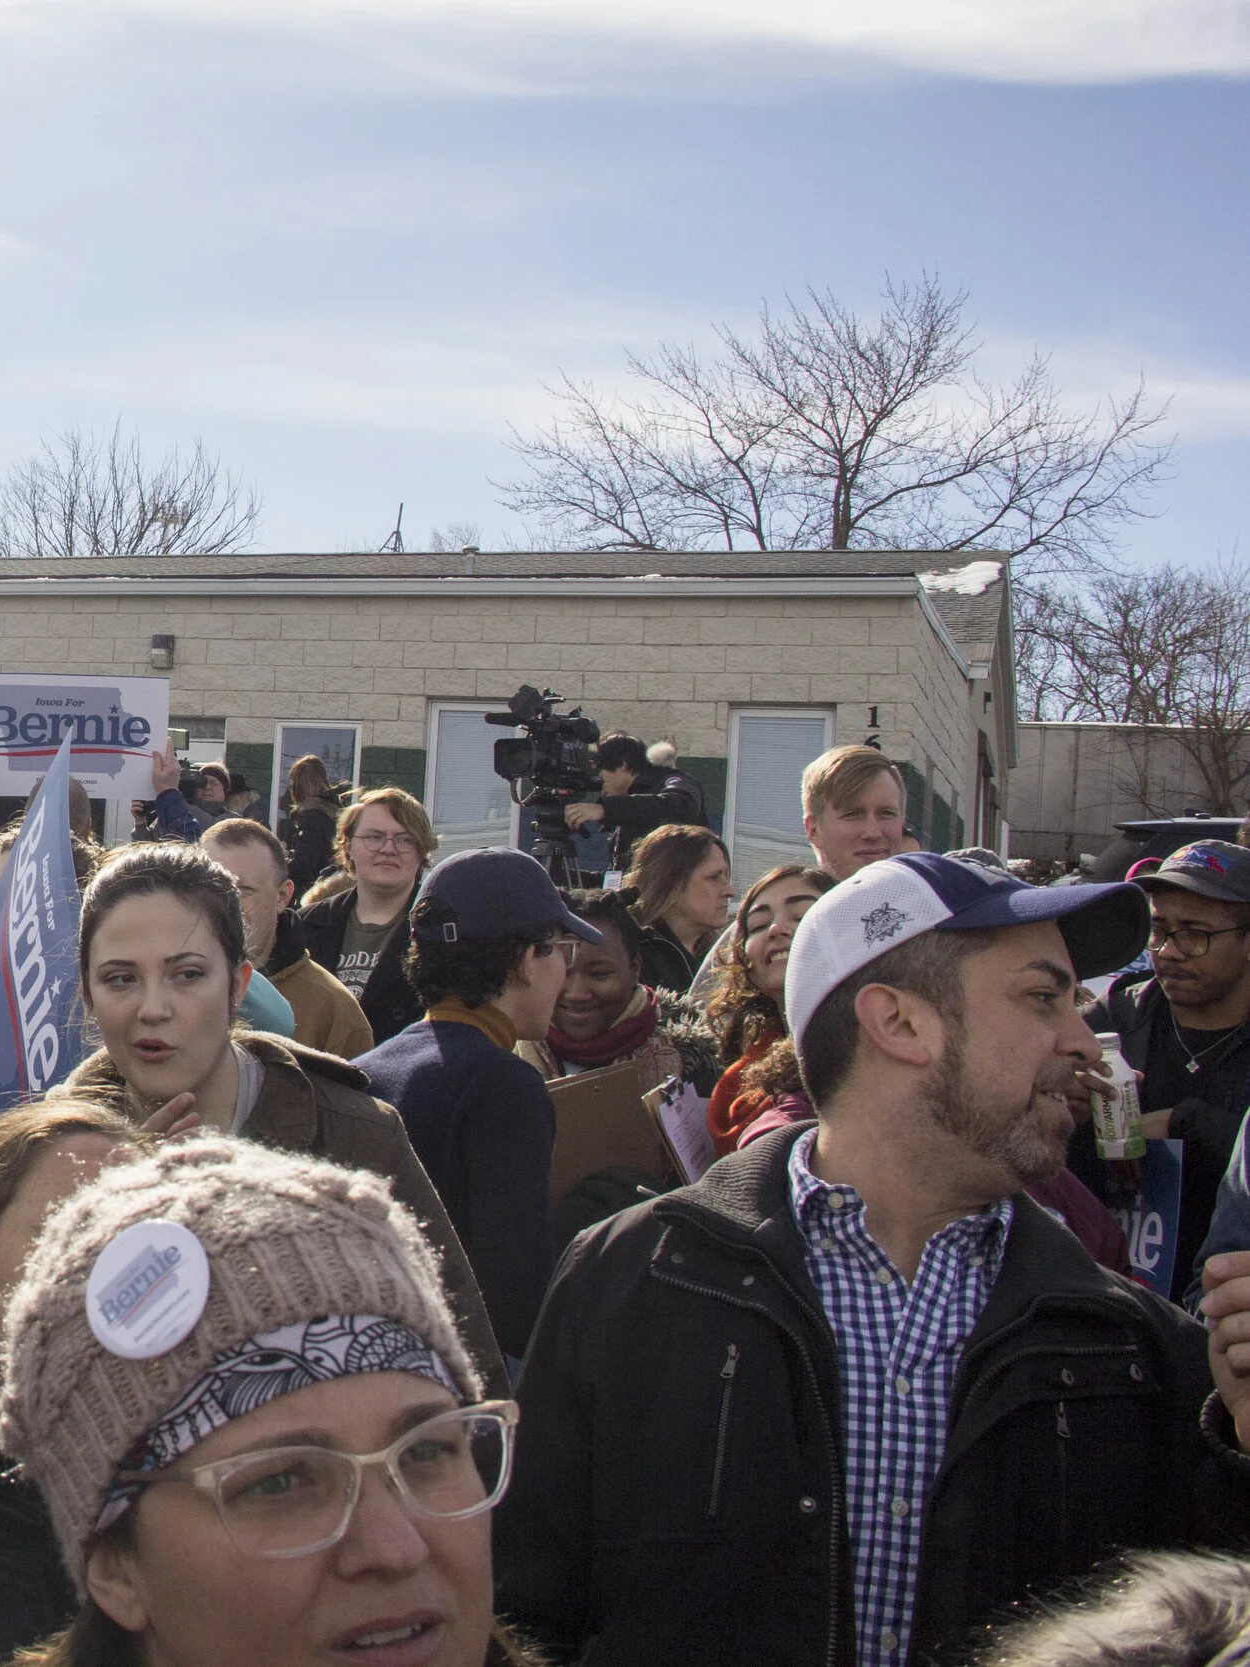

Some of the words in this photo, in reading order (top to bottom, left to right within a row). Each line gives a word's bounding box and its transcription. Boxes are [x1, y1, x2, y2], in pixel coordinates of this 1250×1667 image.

[35, 697, 64, 706] Iowa
[65, 698, 85, 707] For
[42, 852, 50, 900] Iowa
[45, 897, 55, 931] For
[10, 796, 61, 1091] Bernie
[98, 1245, 182, 1325] Bernie
